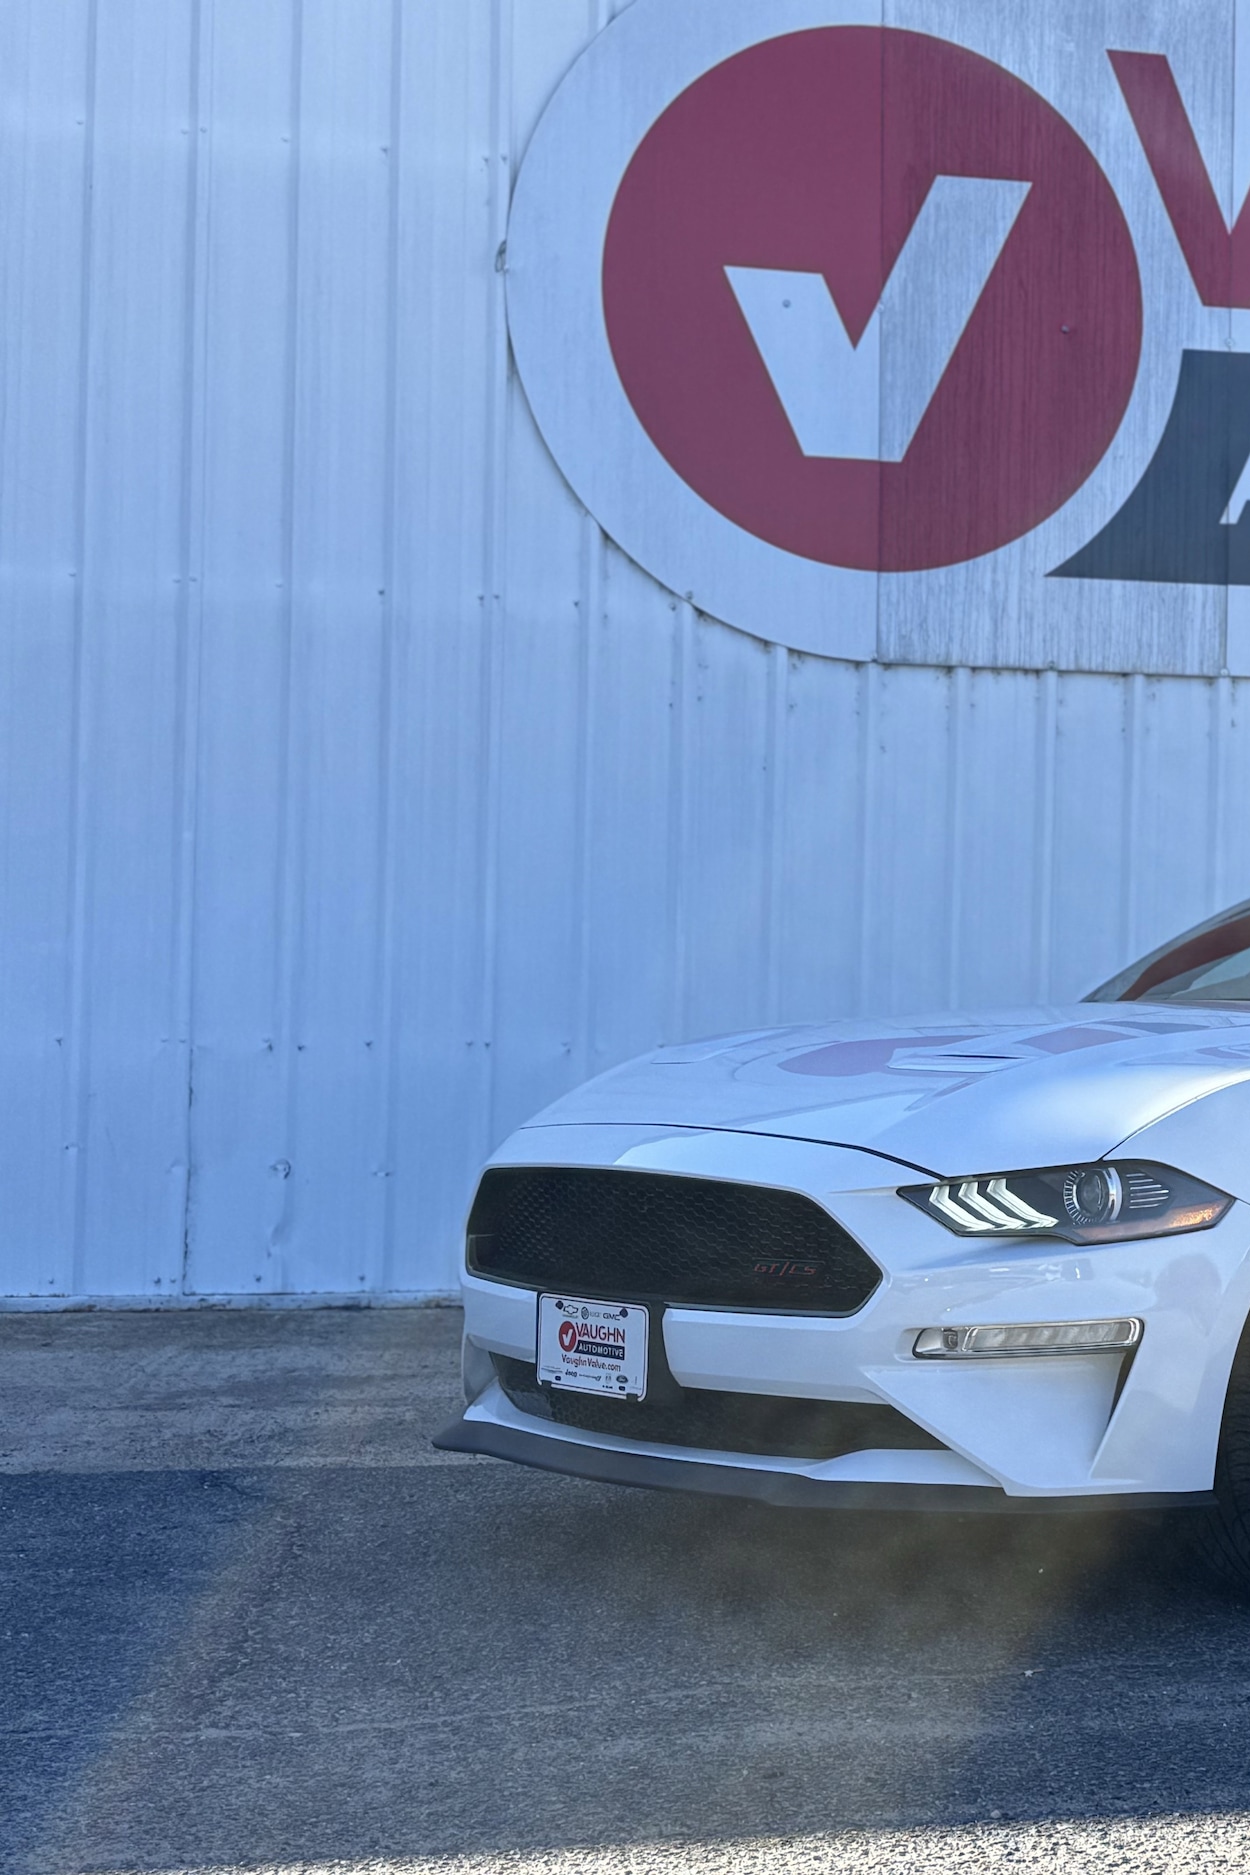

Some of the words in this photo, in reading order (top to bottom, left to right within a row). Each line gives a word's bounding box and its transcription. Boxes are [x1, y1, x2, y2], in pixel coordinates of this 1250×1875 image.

[602, 1312, 621, 1321] GMC
[575, 1322, 626, 1344] VAUGHN
[578, 1342, 624, 1358] AUTOMOTIVE
[561, 1353, 622, 1372] VaughnValue.com
